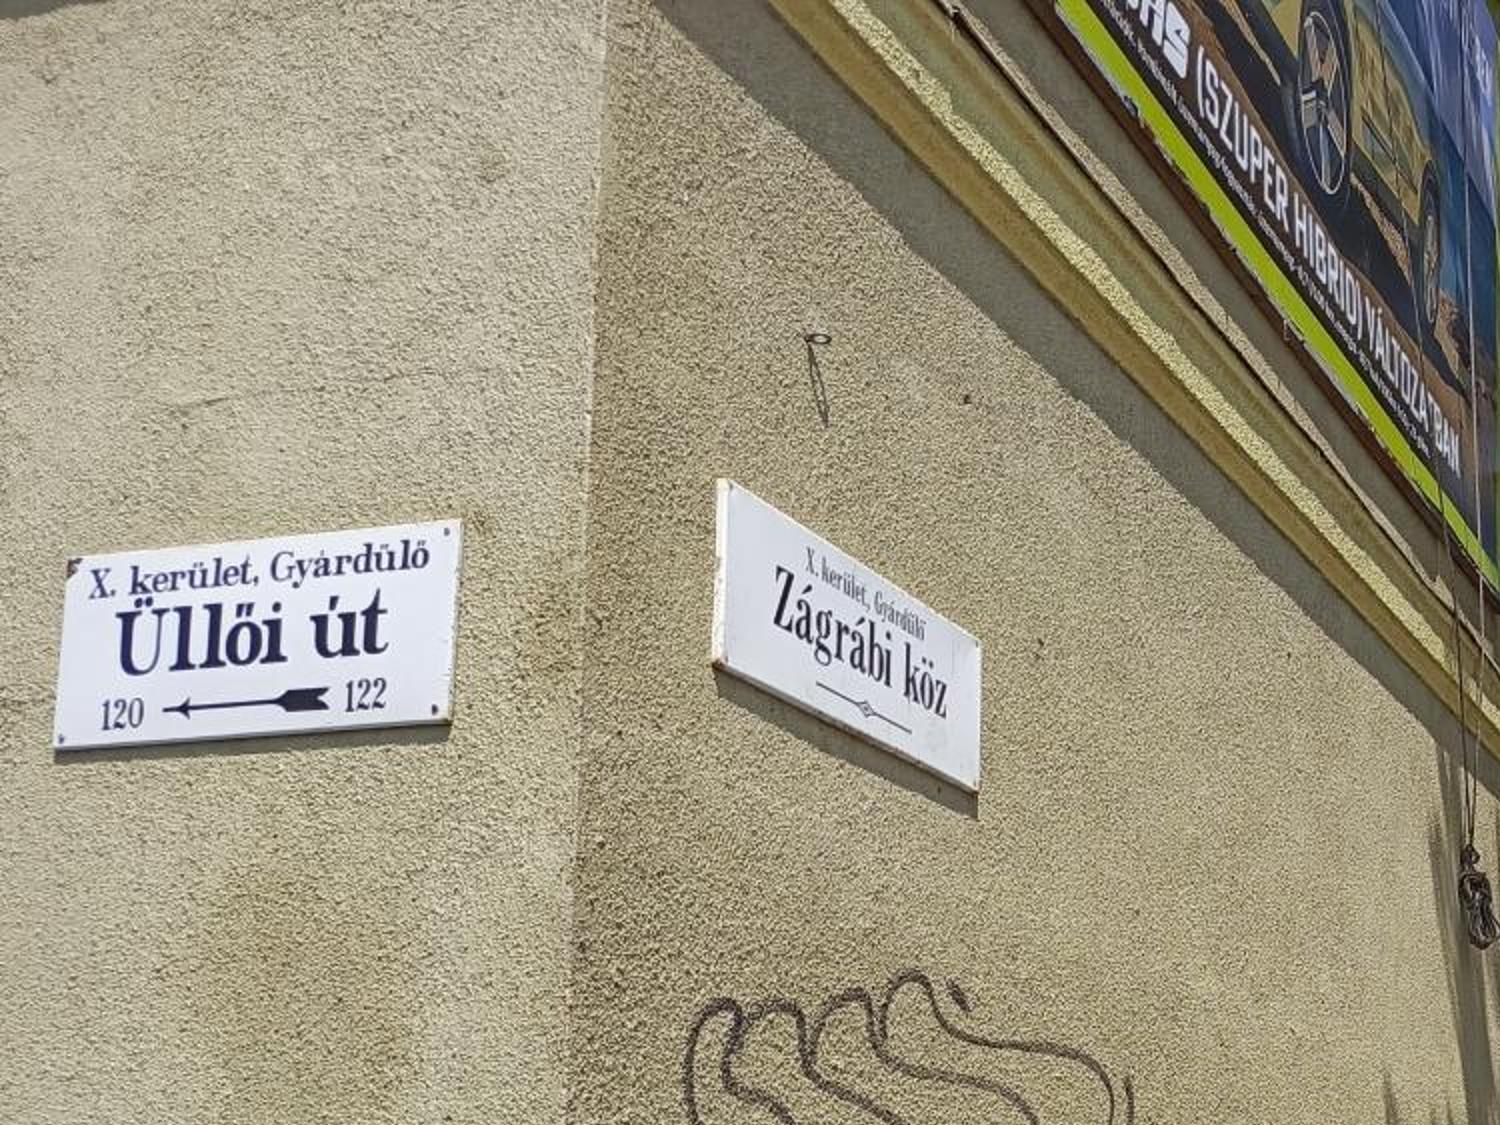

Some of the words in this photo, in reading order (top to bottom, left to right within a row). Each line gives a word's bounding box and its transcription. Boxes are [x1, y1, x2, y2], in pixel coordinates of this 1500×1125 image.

[1126, 0, 1190, 79] HS
[1198, 45, 1289, 232] (SZUPER
[1294, 193, 1363, 341] HIBRID)
[89, 567, 117, 599] X.
[130, 555, 260, 597] kerület,
[806, 546, 819, 577] X.
[116, 596, 288, 677] Üllői
[311, 588, 389, 658] út
[773, 565, 892, 688] Zágrábi
[903, 642, 947, 719] köz
[101, 698, 145, 730] 120
[345, 677, 388, 712] 122
